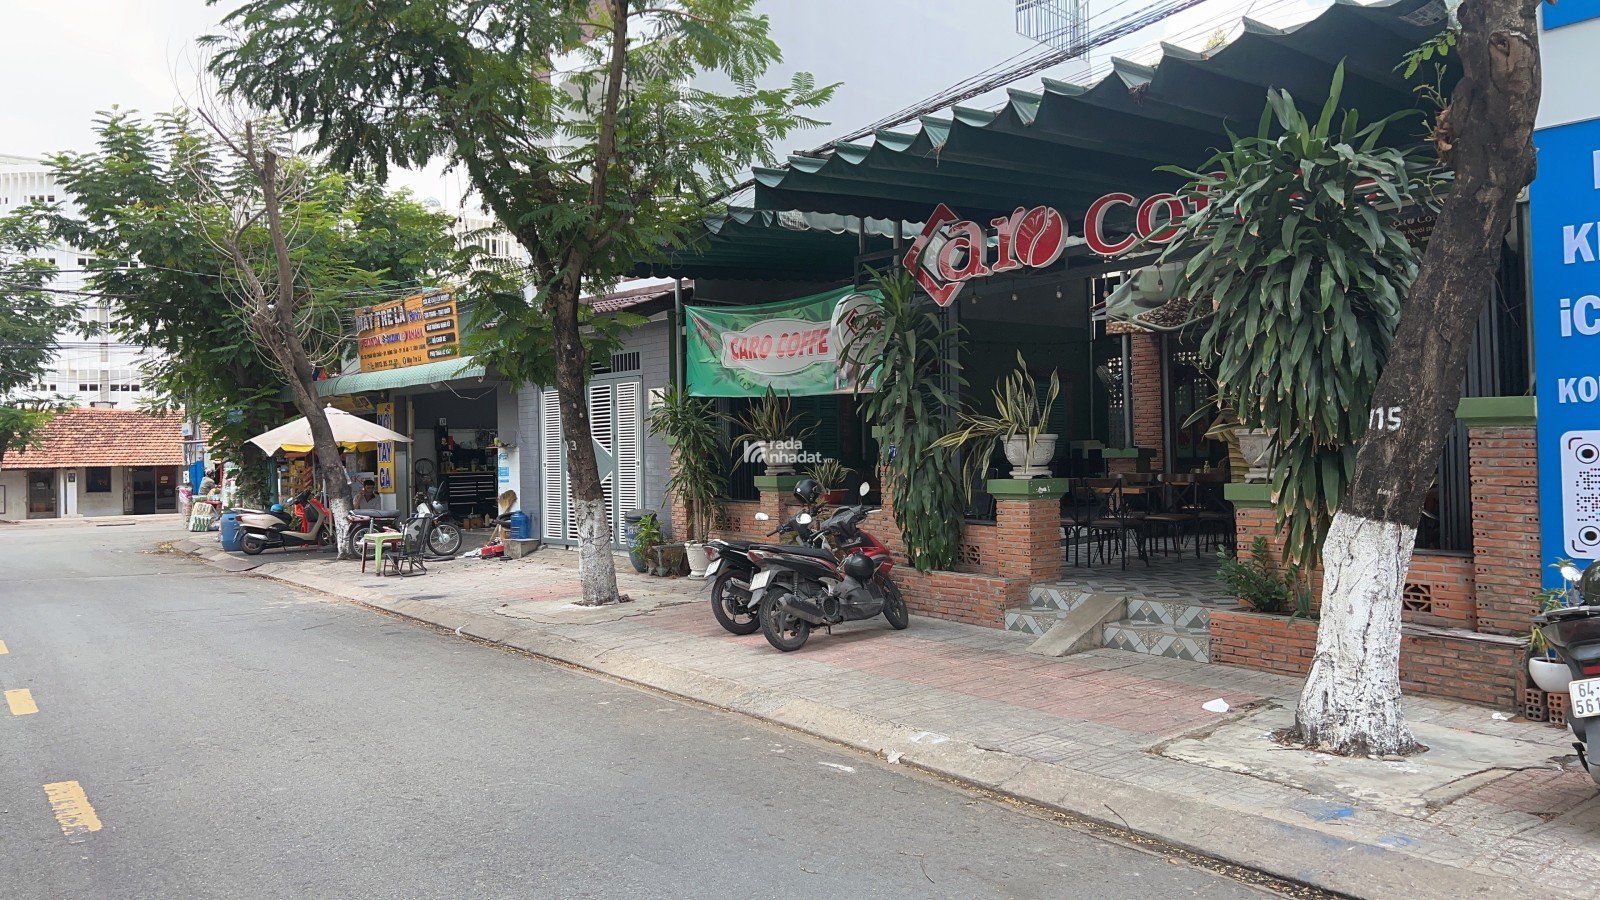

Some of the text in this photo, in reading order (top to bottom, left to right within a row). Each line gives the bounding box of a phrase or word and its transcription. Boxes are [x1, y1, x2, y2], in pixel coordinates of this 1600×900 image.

[1563, 222, 1600, 264] K
[730, 327, 831, 361] CARO COFFE
[1558, 376, 1600, 403] KO
[378, 441, 392, 462] TAY
[379, 467, 392, 488] GA
